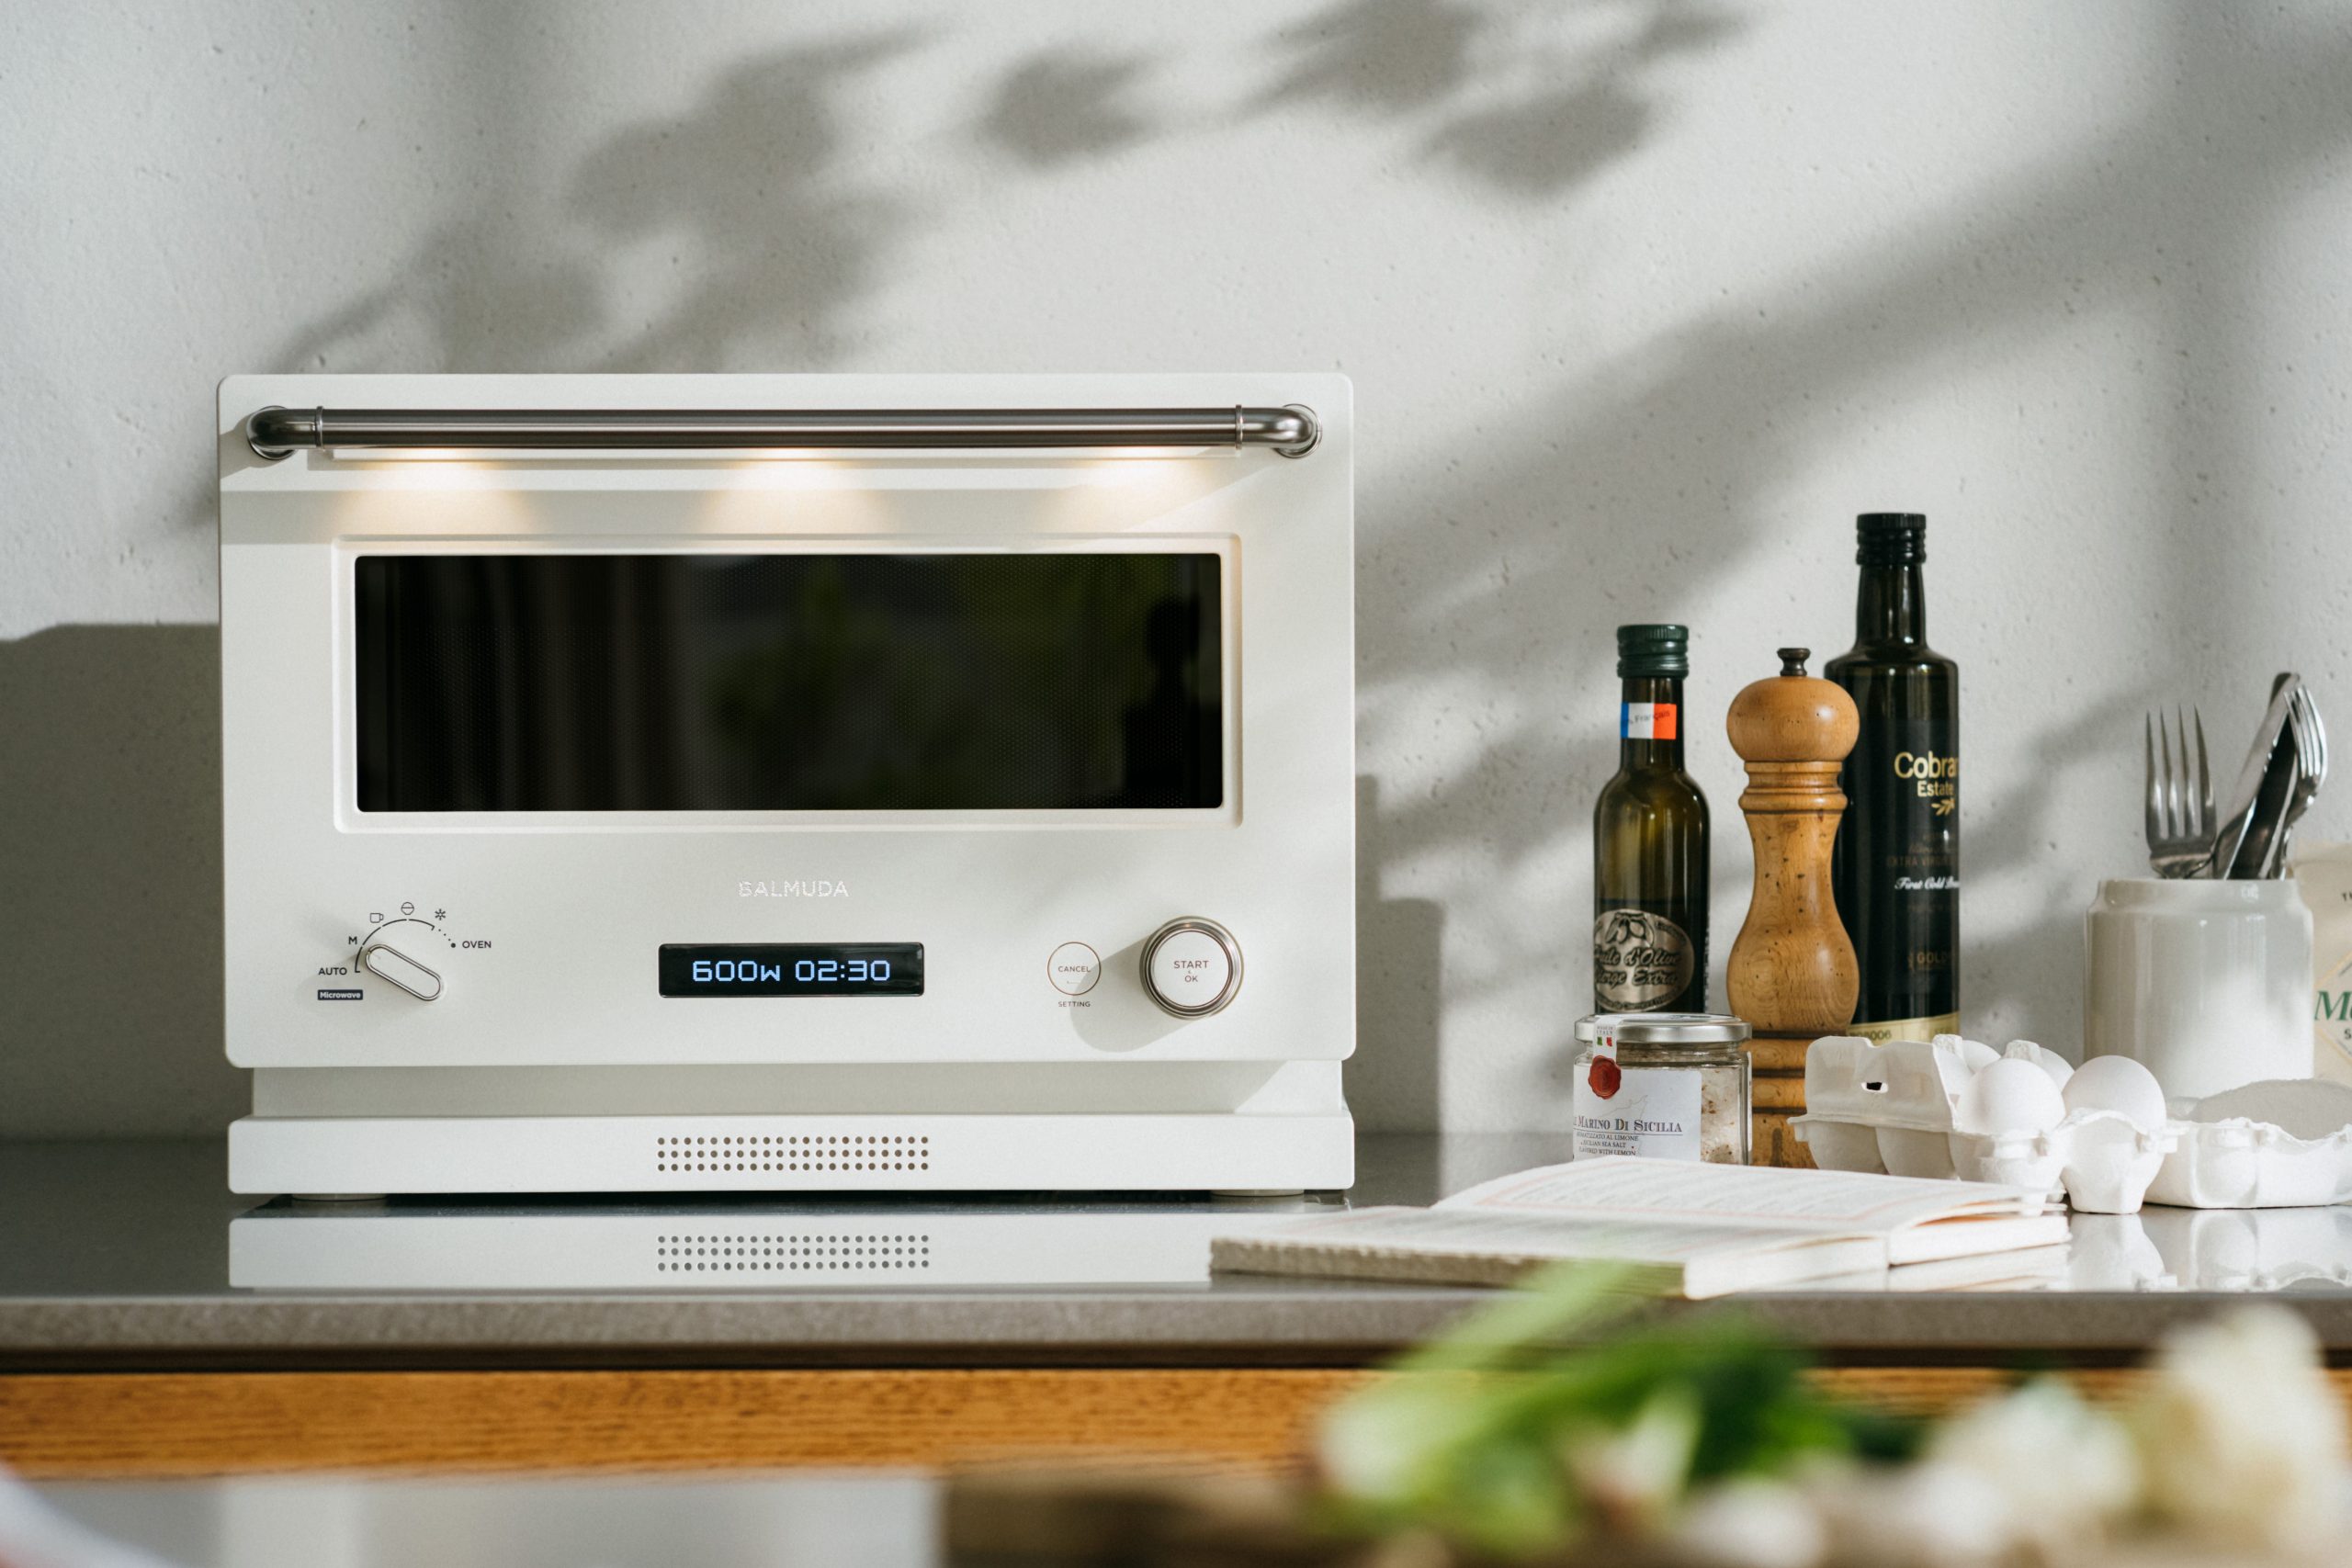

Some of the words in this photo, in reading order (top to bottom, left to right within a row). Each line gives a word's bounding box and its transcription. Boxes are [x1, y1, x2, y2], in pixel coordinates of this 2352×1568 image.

[1917, 782, 1955, 797] Estate
[739, 880, 849, 897] BALMUDA
[348, 936, 357, 944] M
[462, 940, 492, 949] OVEN
[1173, 960, 1209, 969] START
[318, 967, 347, 976] AUTO
[795, 960, 890, 982] 02:30
[1184, 975, 1198, 983] OK
[320, 991, 361, 999] Microwave
[1577, 1115, 1610, 1130] MARINO
[1634, 1119, 1682, 1133] SICILIA
